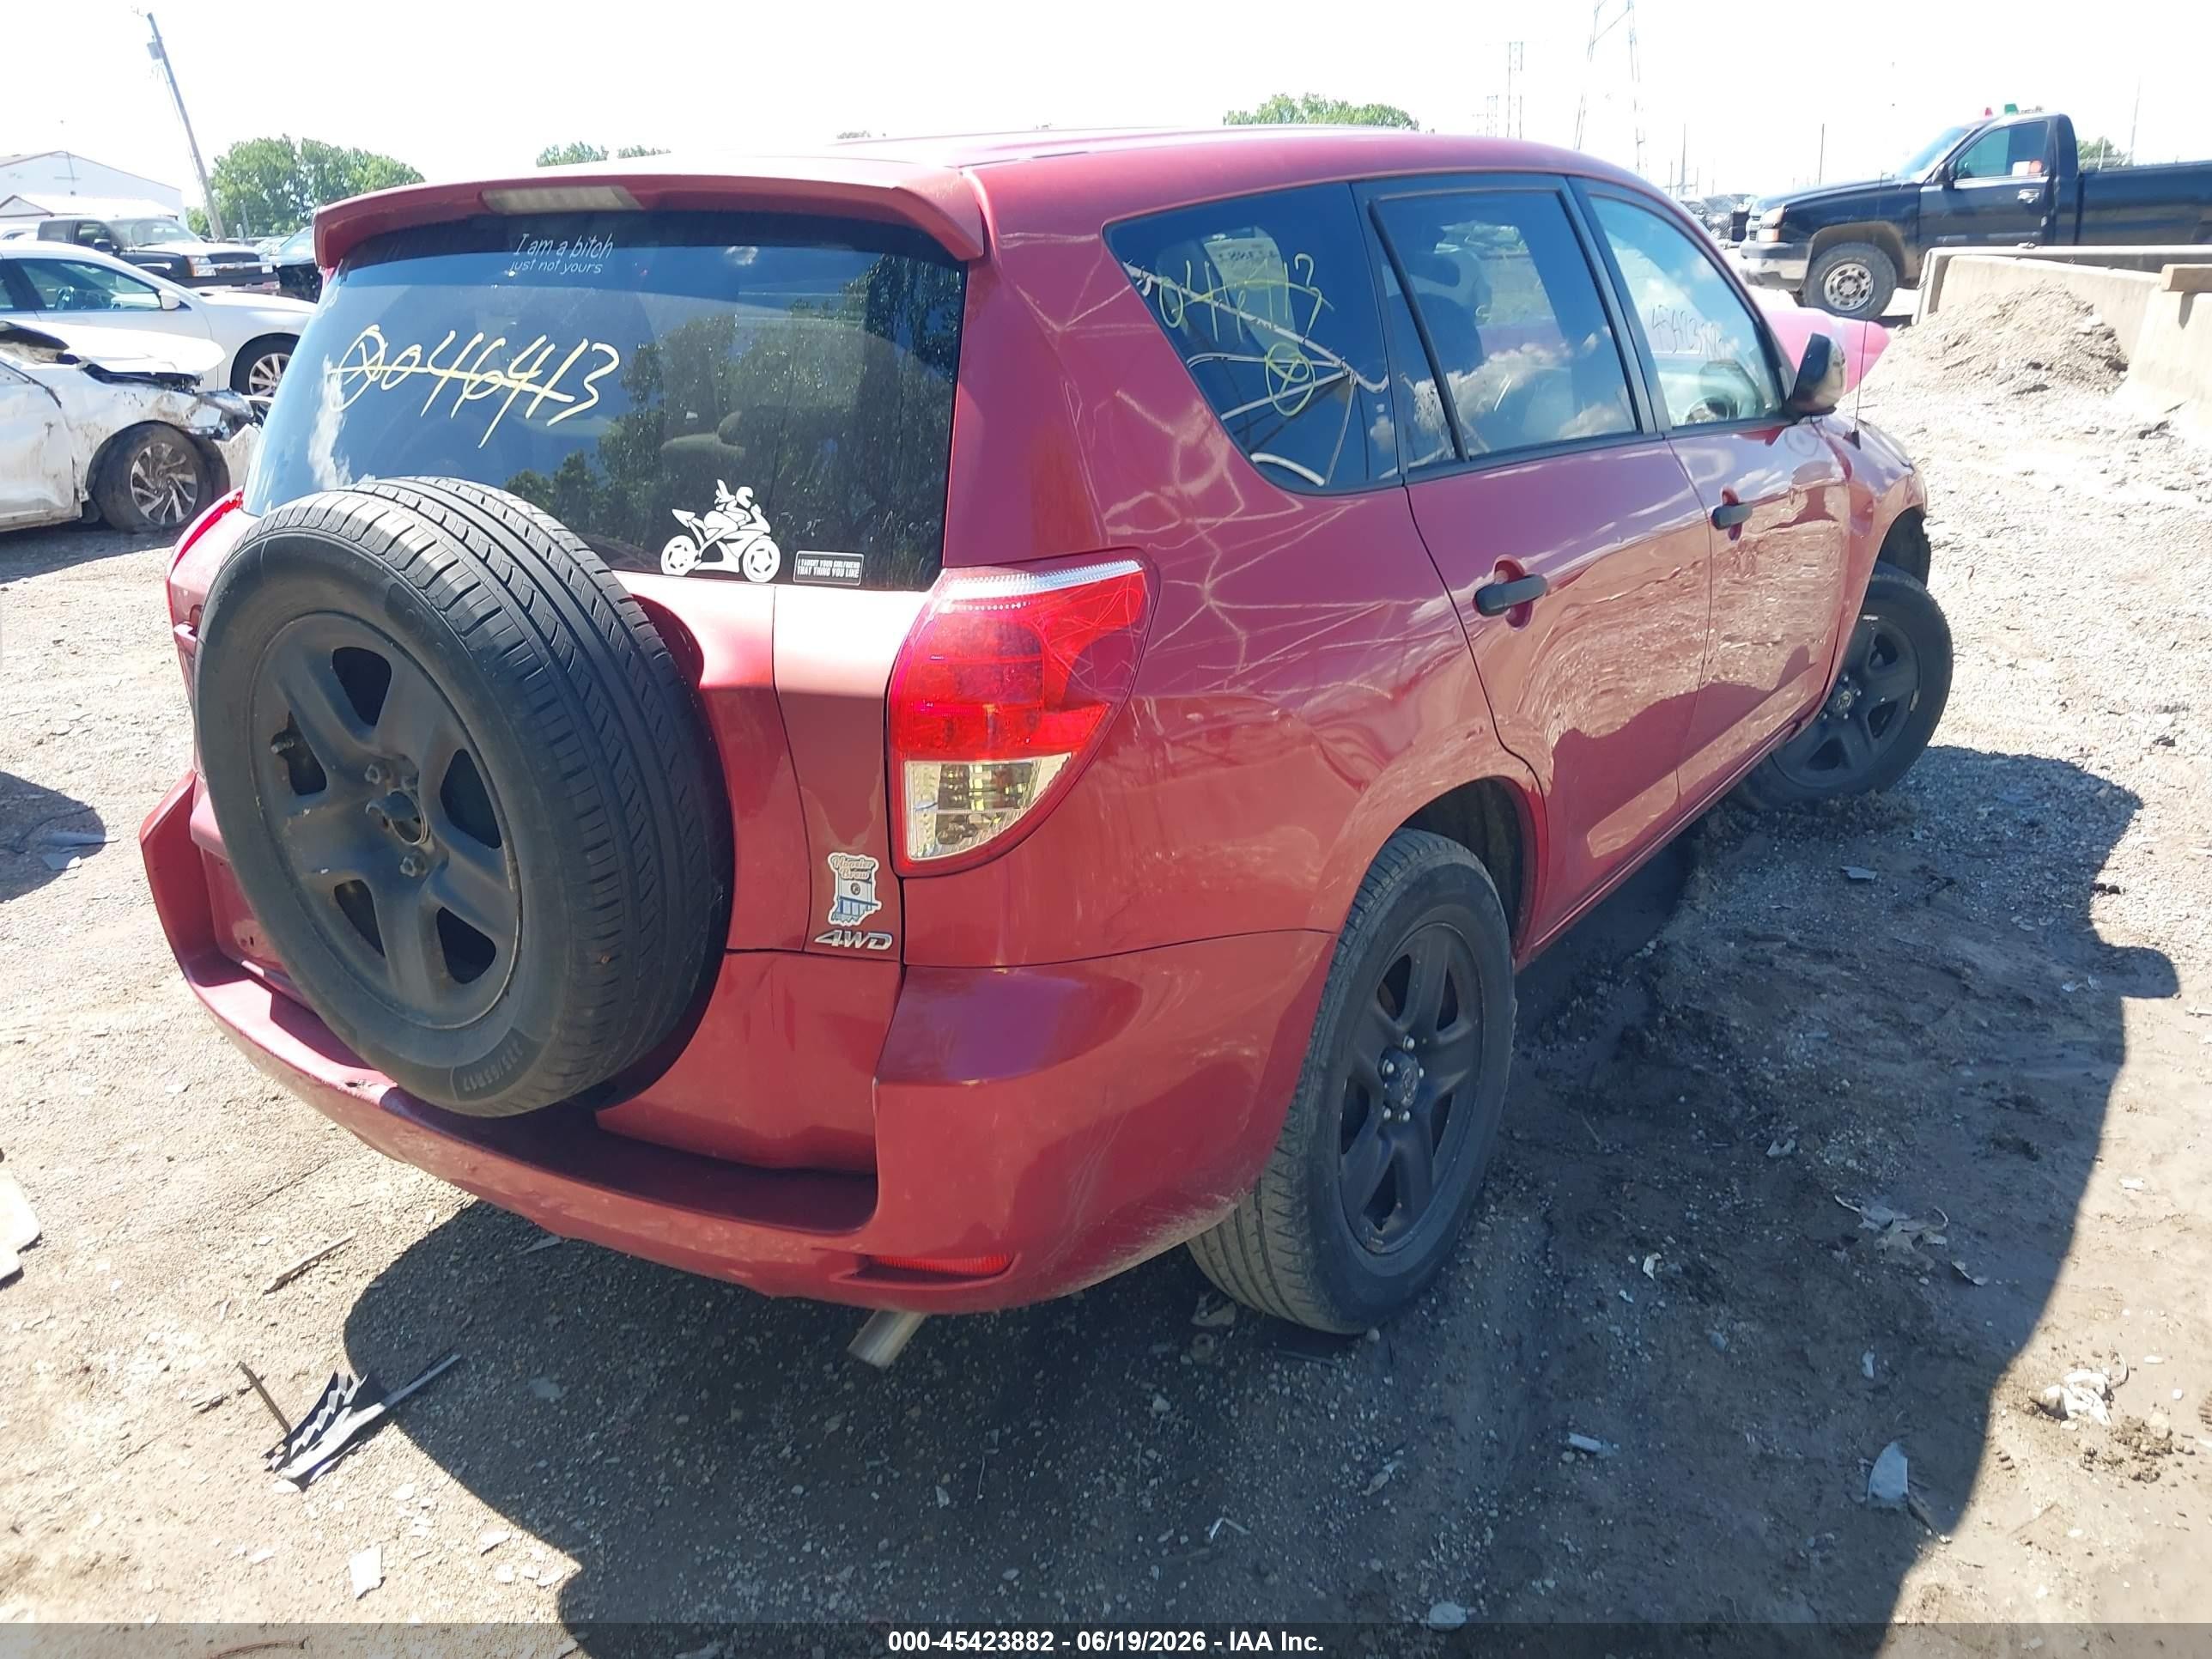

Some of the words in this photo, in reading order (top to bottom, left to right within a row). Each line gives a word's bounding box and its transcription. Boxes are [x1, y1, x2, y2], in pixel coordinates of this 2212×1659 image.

[513, 233, 530, 256] I
[526, 240, 554, 257] am
[556, 240, 568, 257] a
[569, 233, 613, 259] bitch
[510, 258, 537, 272] just
[538, 258, 561, 272] not
[559, 263, 603, 275] yours
[797, 567, 812, 576] THAT
[832, 568, 845, 578] YOU
[845, 568, 860, 578] LIKE
[814, 929, 893, 950] 4WD
